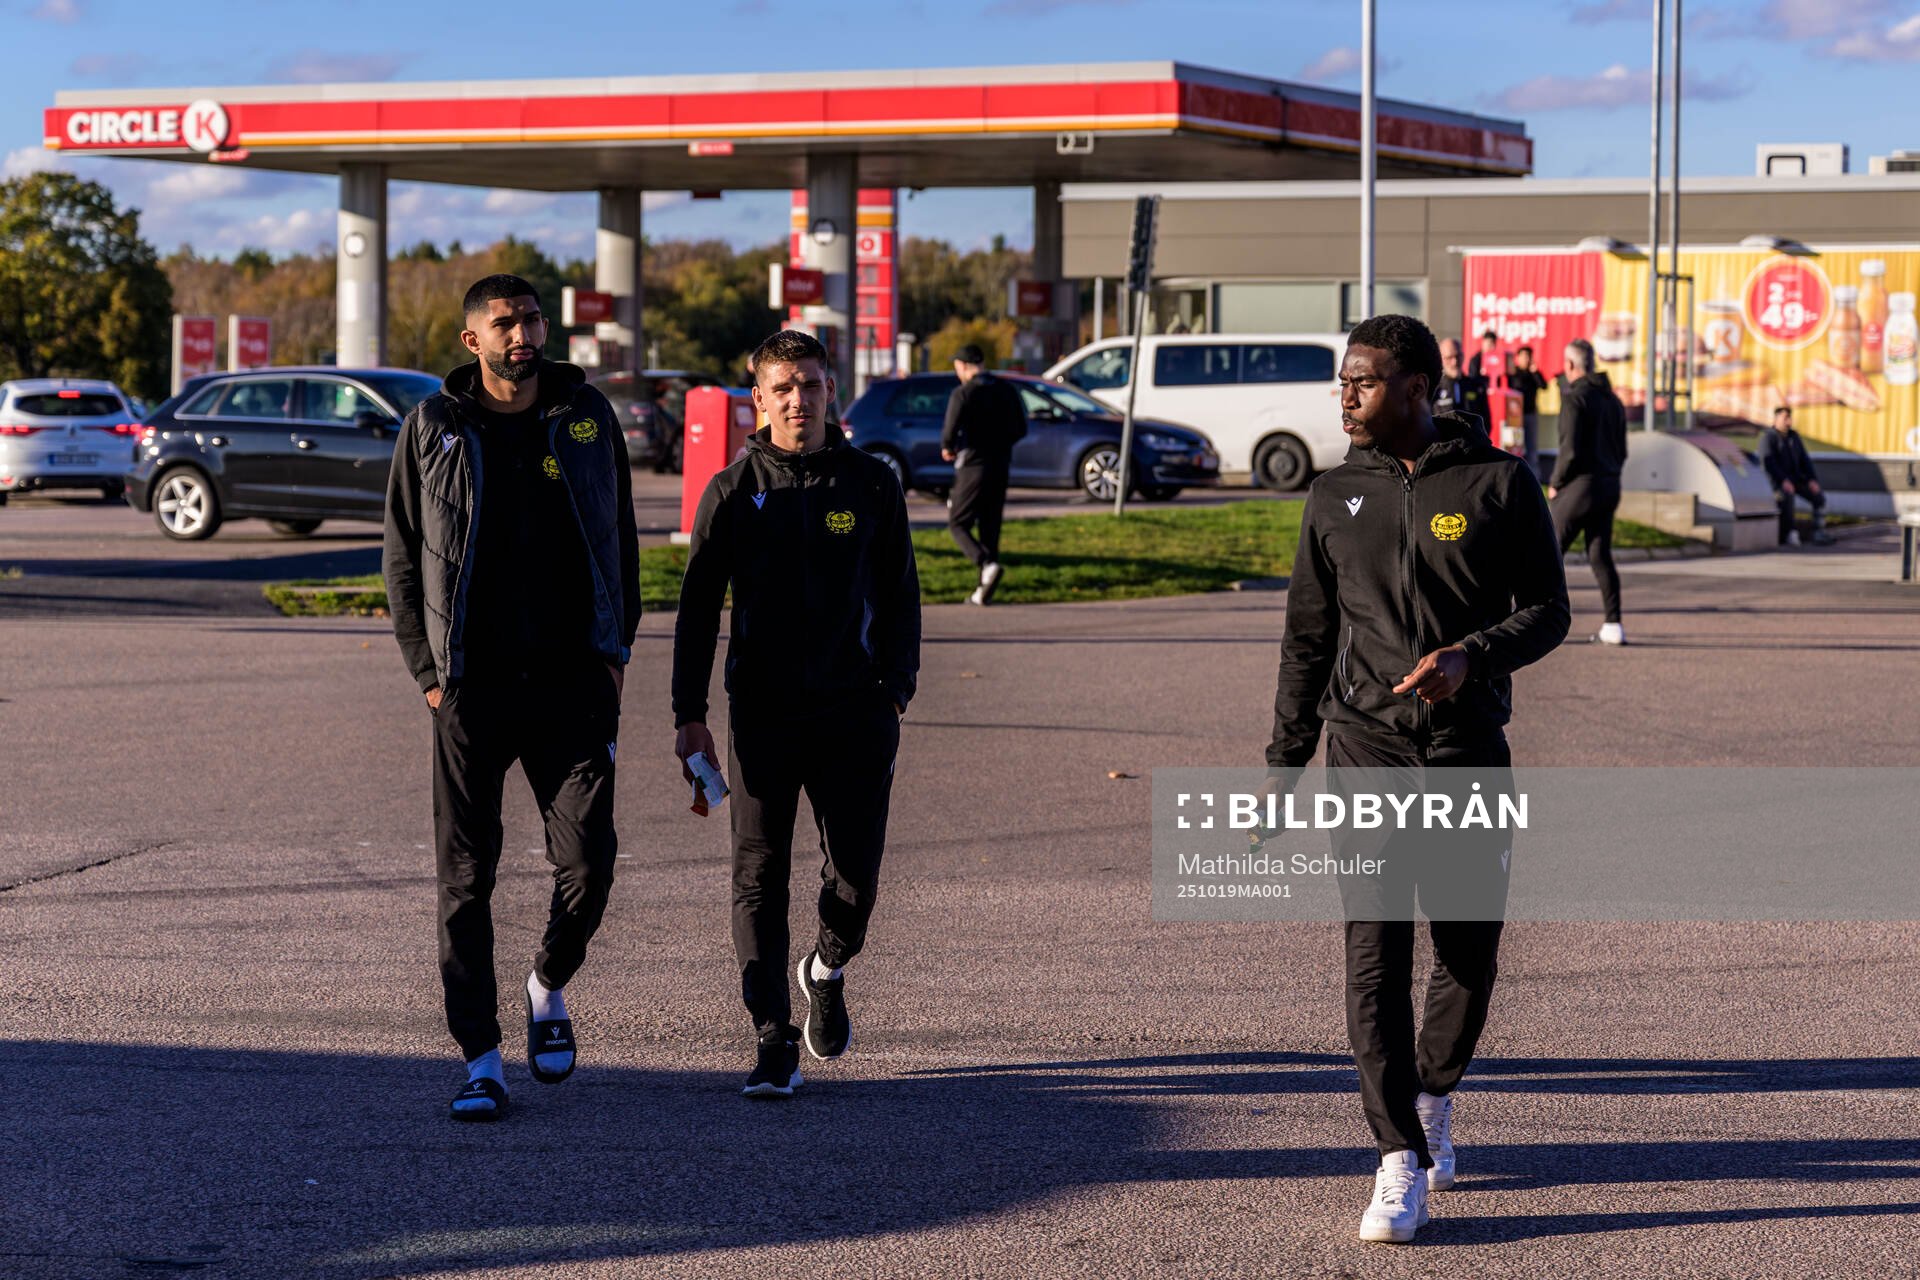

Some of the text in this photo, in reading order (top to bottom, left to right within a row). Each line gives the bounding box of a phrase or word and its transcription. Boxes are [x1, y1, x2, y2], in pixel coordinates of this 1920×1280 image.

[67, 110, 221, 146] CIRCLE K
[1472, 292, 1597, 315] Medlems-
[1768, 282, 1785, 303] 2
